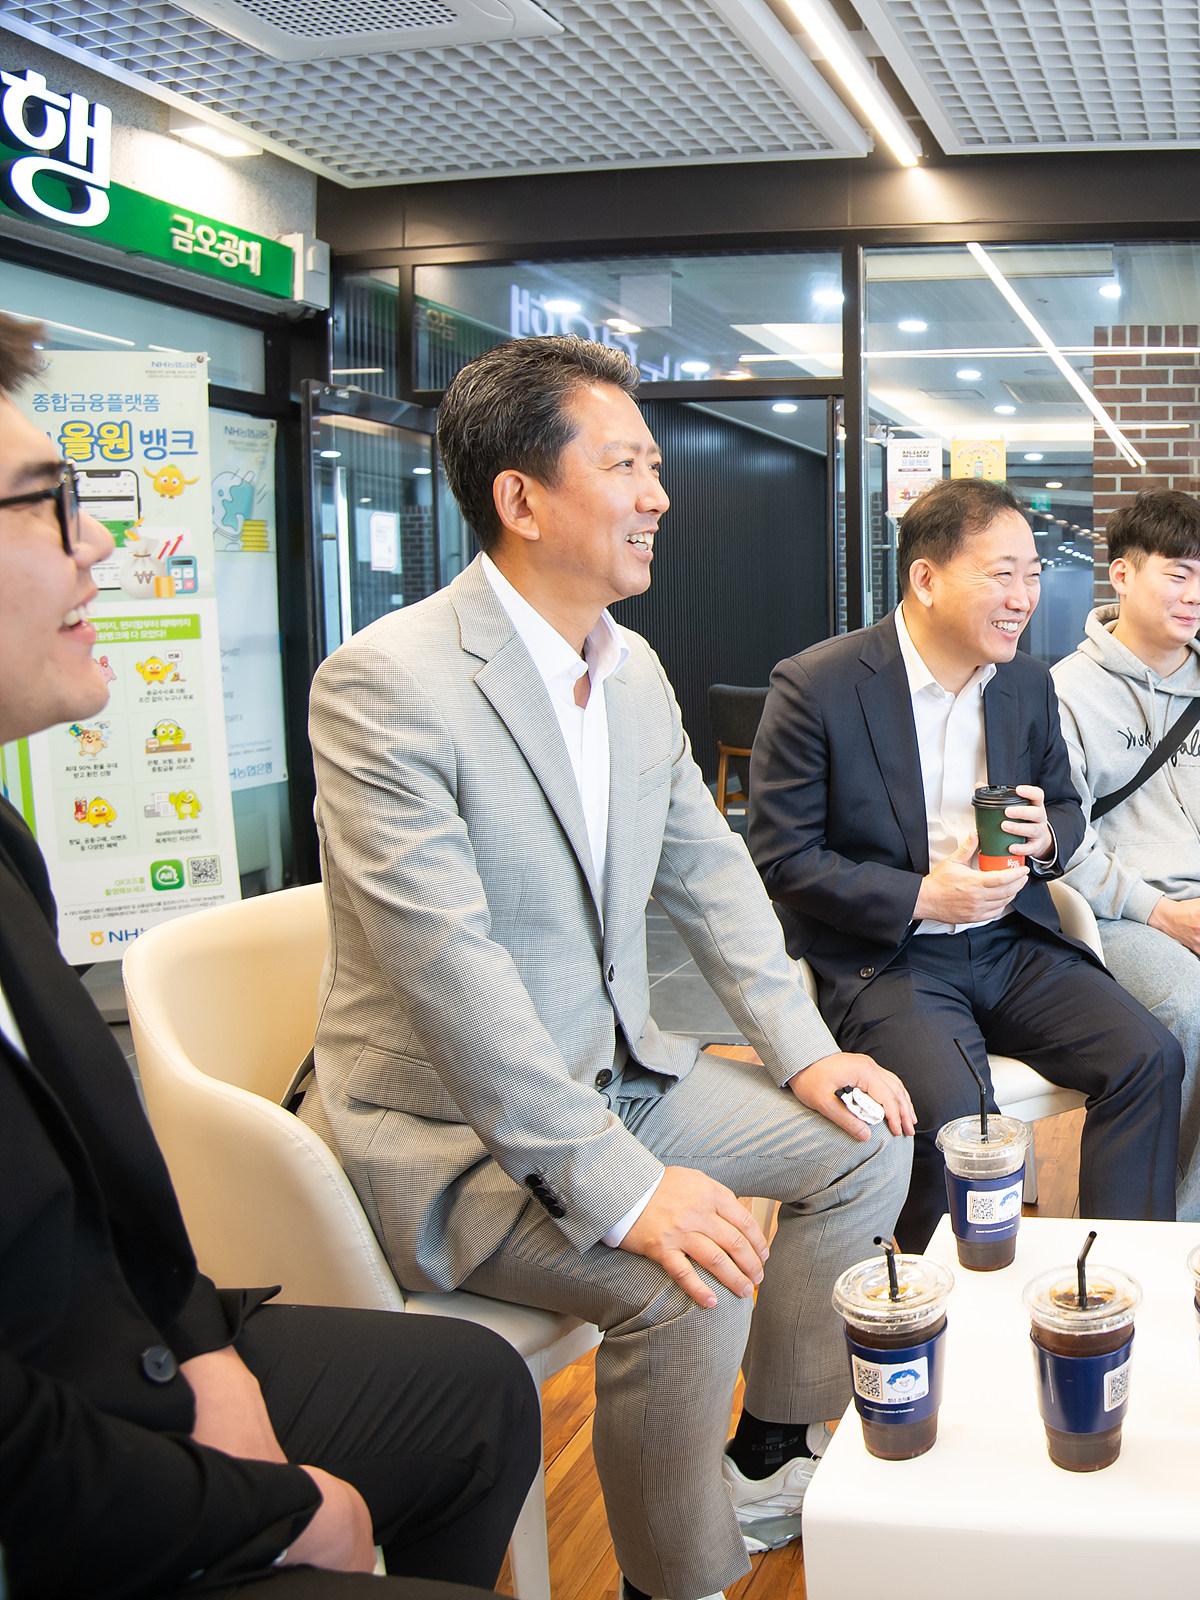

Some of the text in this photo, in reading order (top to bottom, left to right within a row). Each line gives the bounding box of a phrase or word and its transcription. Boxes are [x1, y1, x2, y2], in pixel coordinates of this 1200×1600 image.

[0, 68, 112, 227] 행
[169, 214, 262, 276] 금오공대
[32, 393, 160, 412] 종합금융플랫폼
[57, 420, 198, 463] 올원 뱅크
